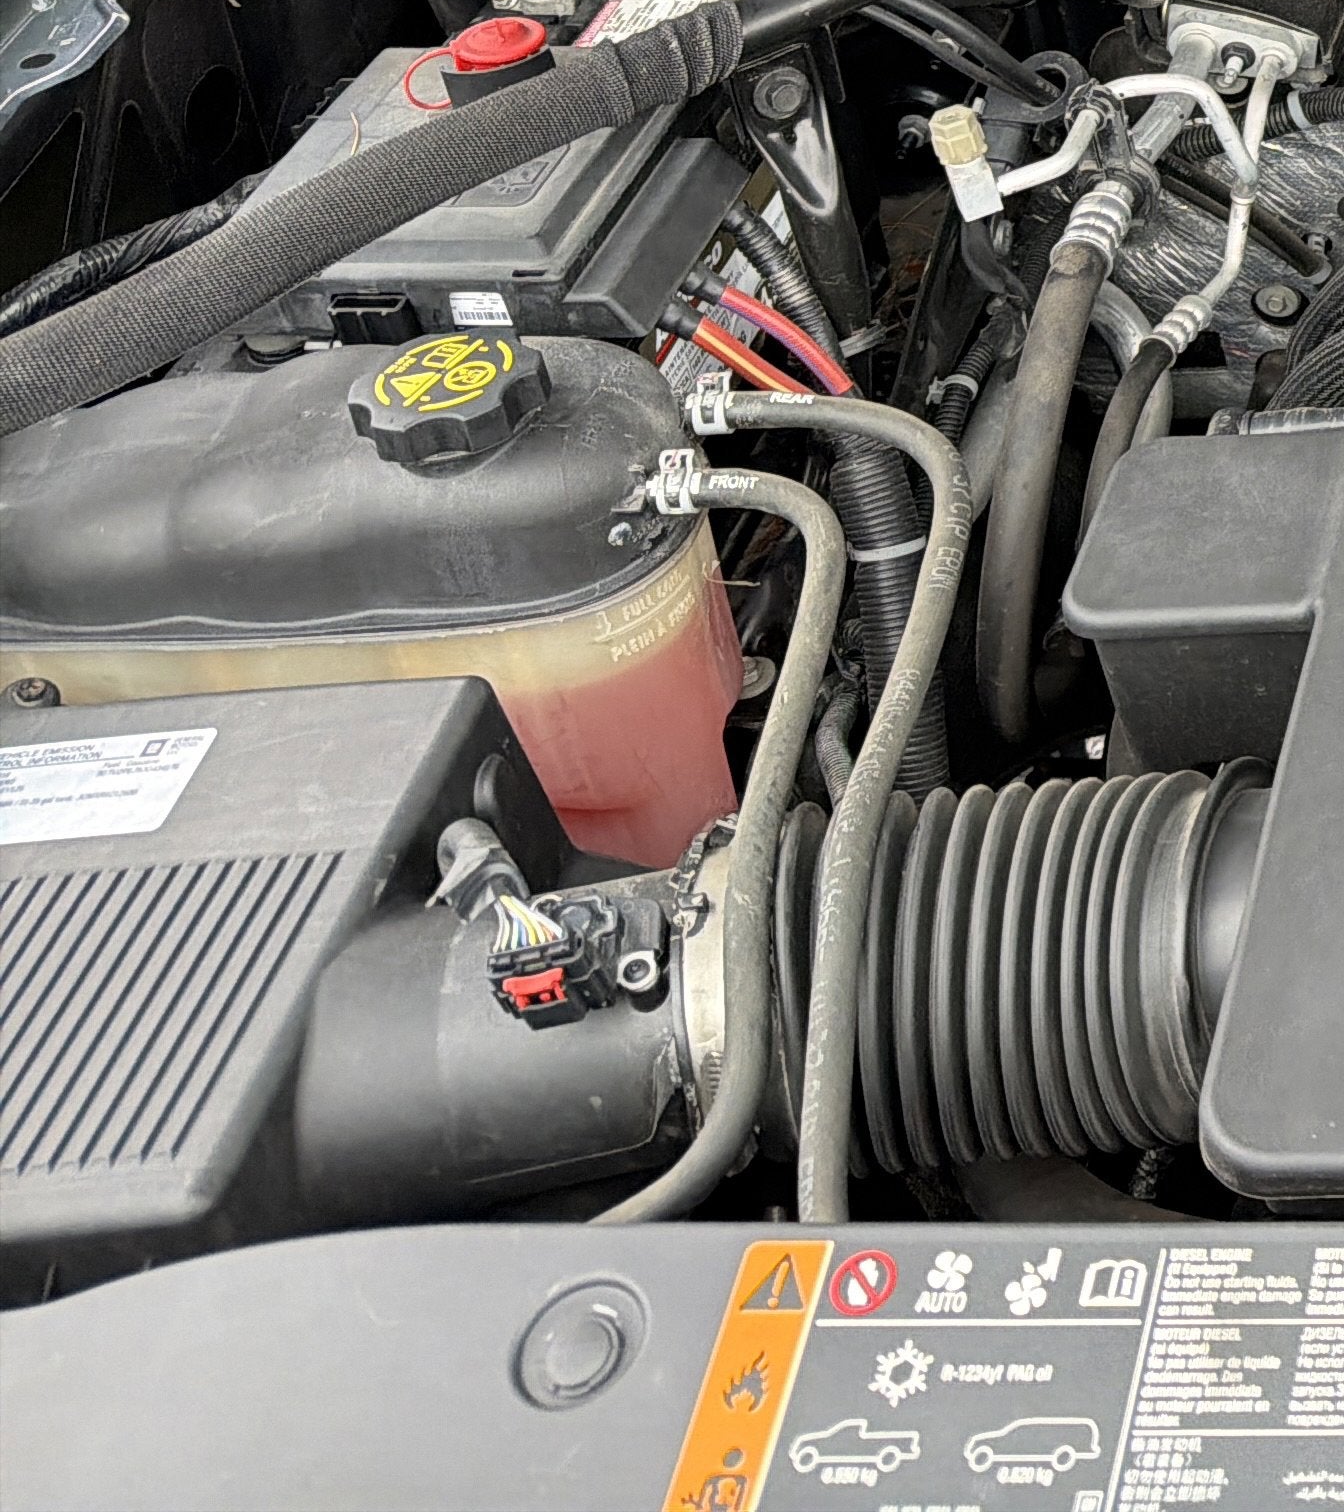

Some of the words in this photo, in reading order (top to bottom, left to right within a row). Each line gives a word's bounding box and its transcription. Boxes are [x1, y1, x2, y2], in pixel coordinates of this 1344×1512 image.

[770, 391, 816, 404] REAR
[708, 474, 760, 490] FRONT
[945, 503, 972, 541] CIP
[622, 593, 656, 622] FULL
[26, 751, 104, 766] INFORMATION
[1223, 1276, 1265, 1291] starting
[914, 1290, 968, 1313] AUTO
[1258, 1290, 1303, 1305] damage
[1202, 1327, 1242, 1341] DIESEL
[1221, 1369, 1243, 1383] Des
[860, 1467, 879, 1487] kg
[1034, 1467, 1054, 1487] kg
